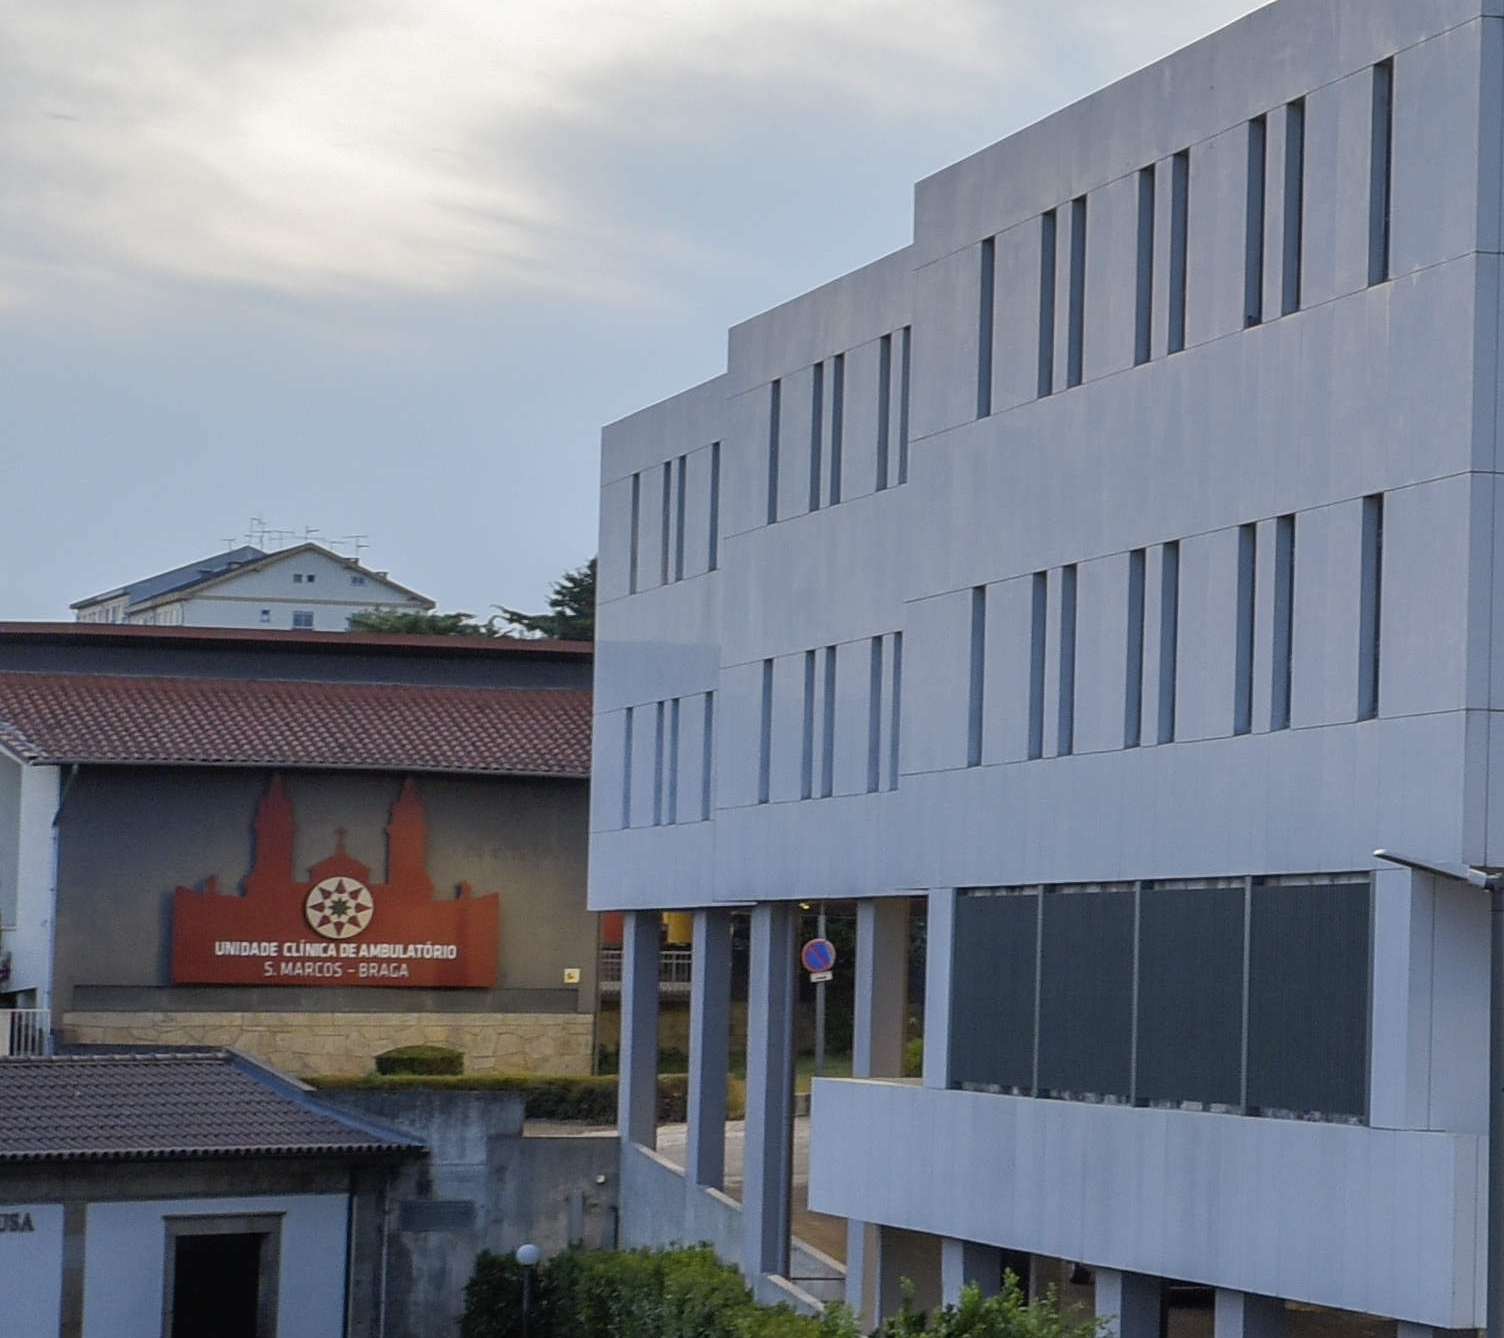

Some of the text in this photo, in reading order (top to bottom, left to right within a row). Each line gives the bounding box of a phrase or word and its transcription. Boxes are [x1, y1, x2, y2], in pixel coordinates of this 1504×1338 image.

[214, 938, 458, 960] UNIDADE CLÍNICA DE AMBULATÓRIO
[263, 961, 277, 977] S.
[280, 961, 343, 978] MARCOS
[358, 962, 410, 978] BRAGA
